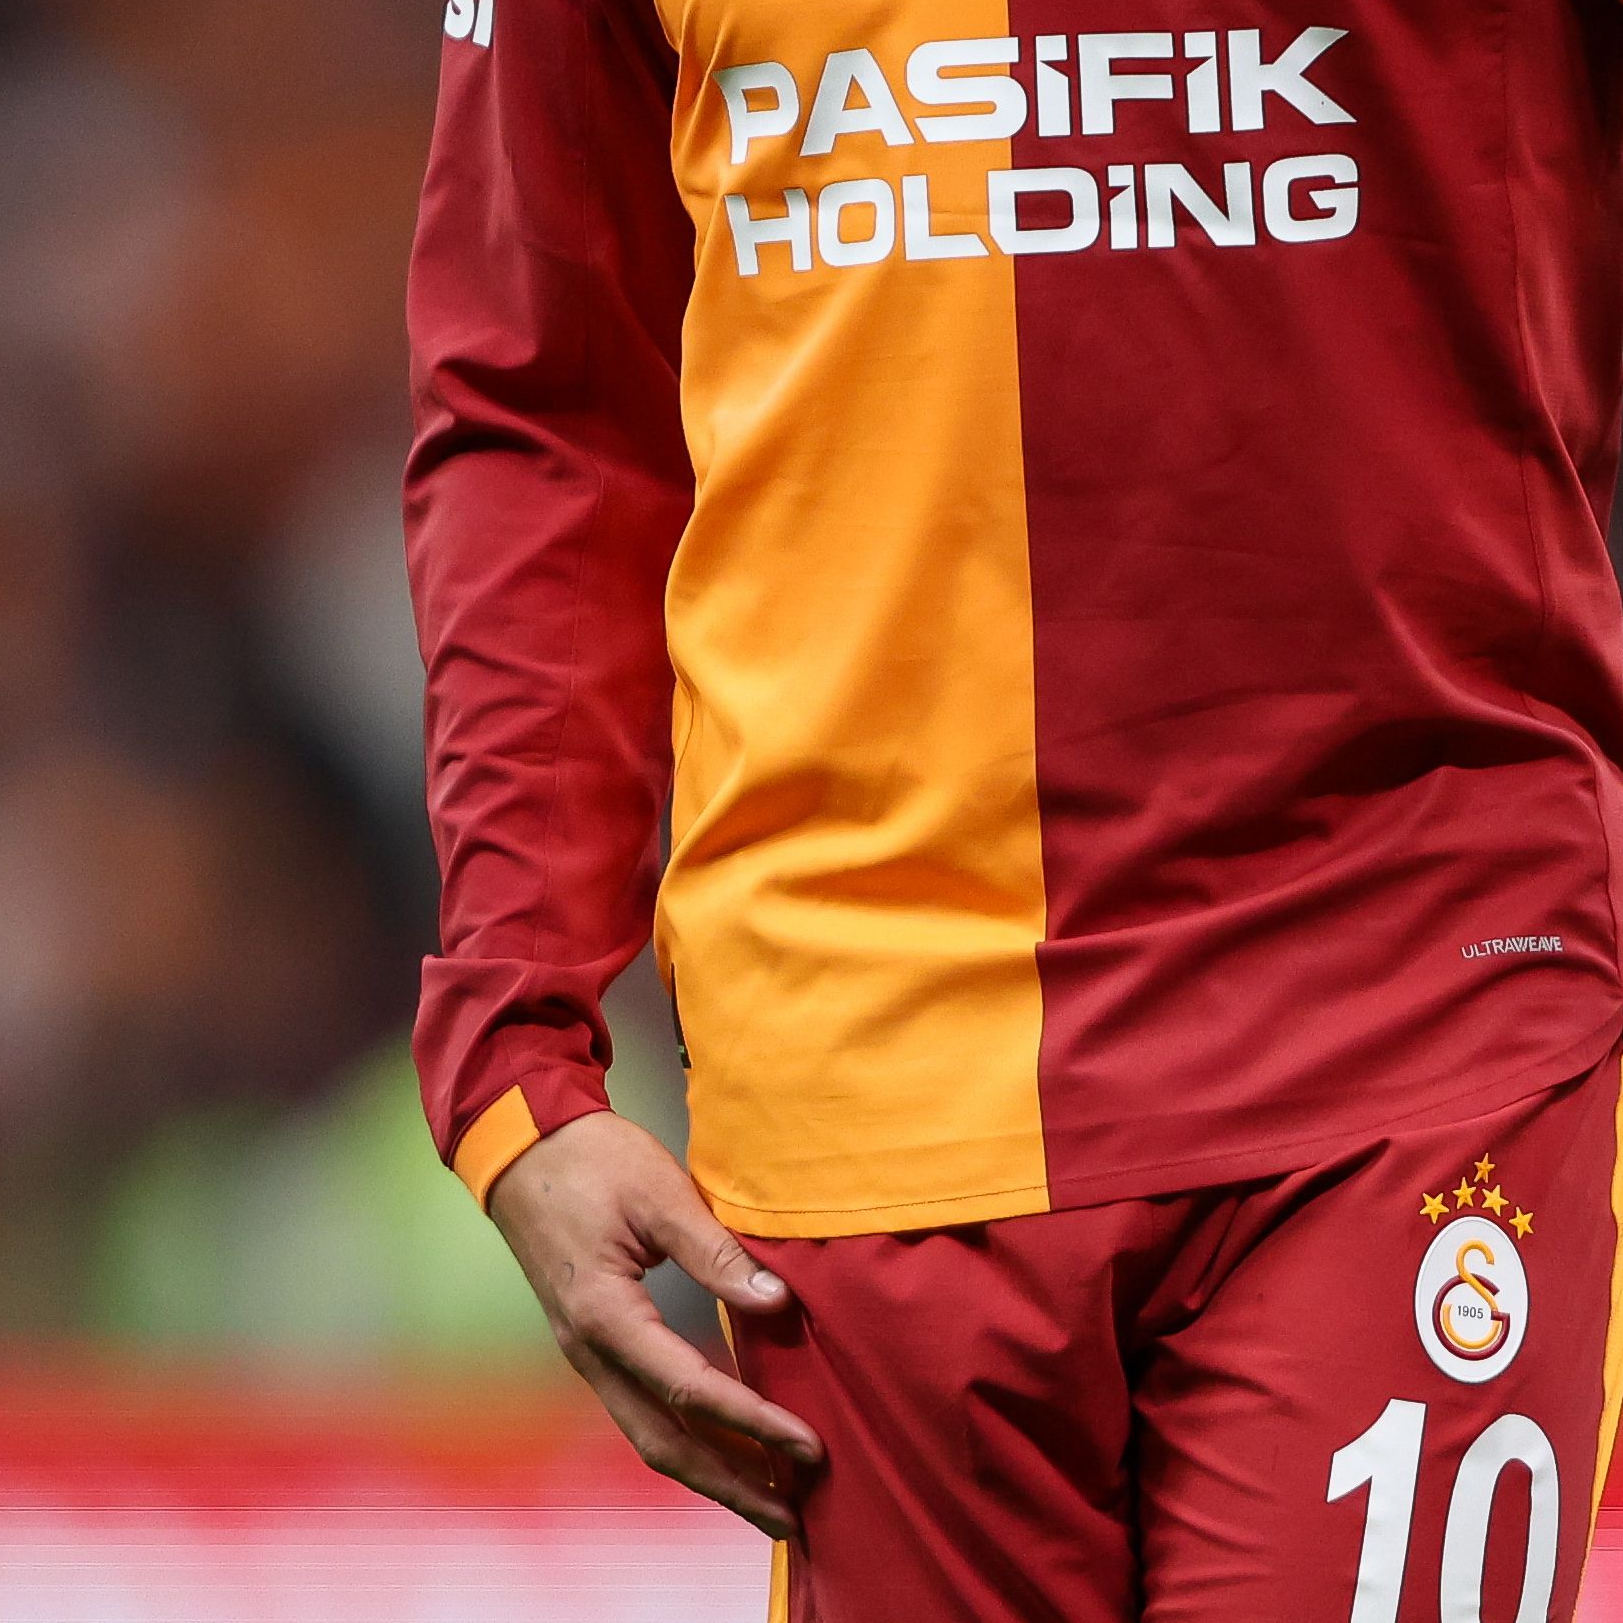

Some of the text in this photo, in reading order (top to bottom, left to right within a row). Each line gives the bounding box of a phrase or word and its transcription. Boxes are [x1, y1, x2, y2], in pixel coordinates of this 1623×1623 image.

[1461, 936, 1563, 959] ULTRAWEAVE
[1457, 1305, 1484, 1320] 1905
[1326, 1398, 1560, 1623] 10
